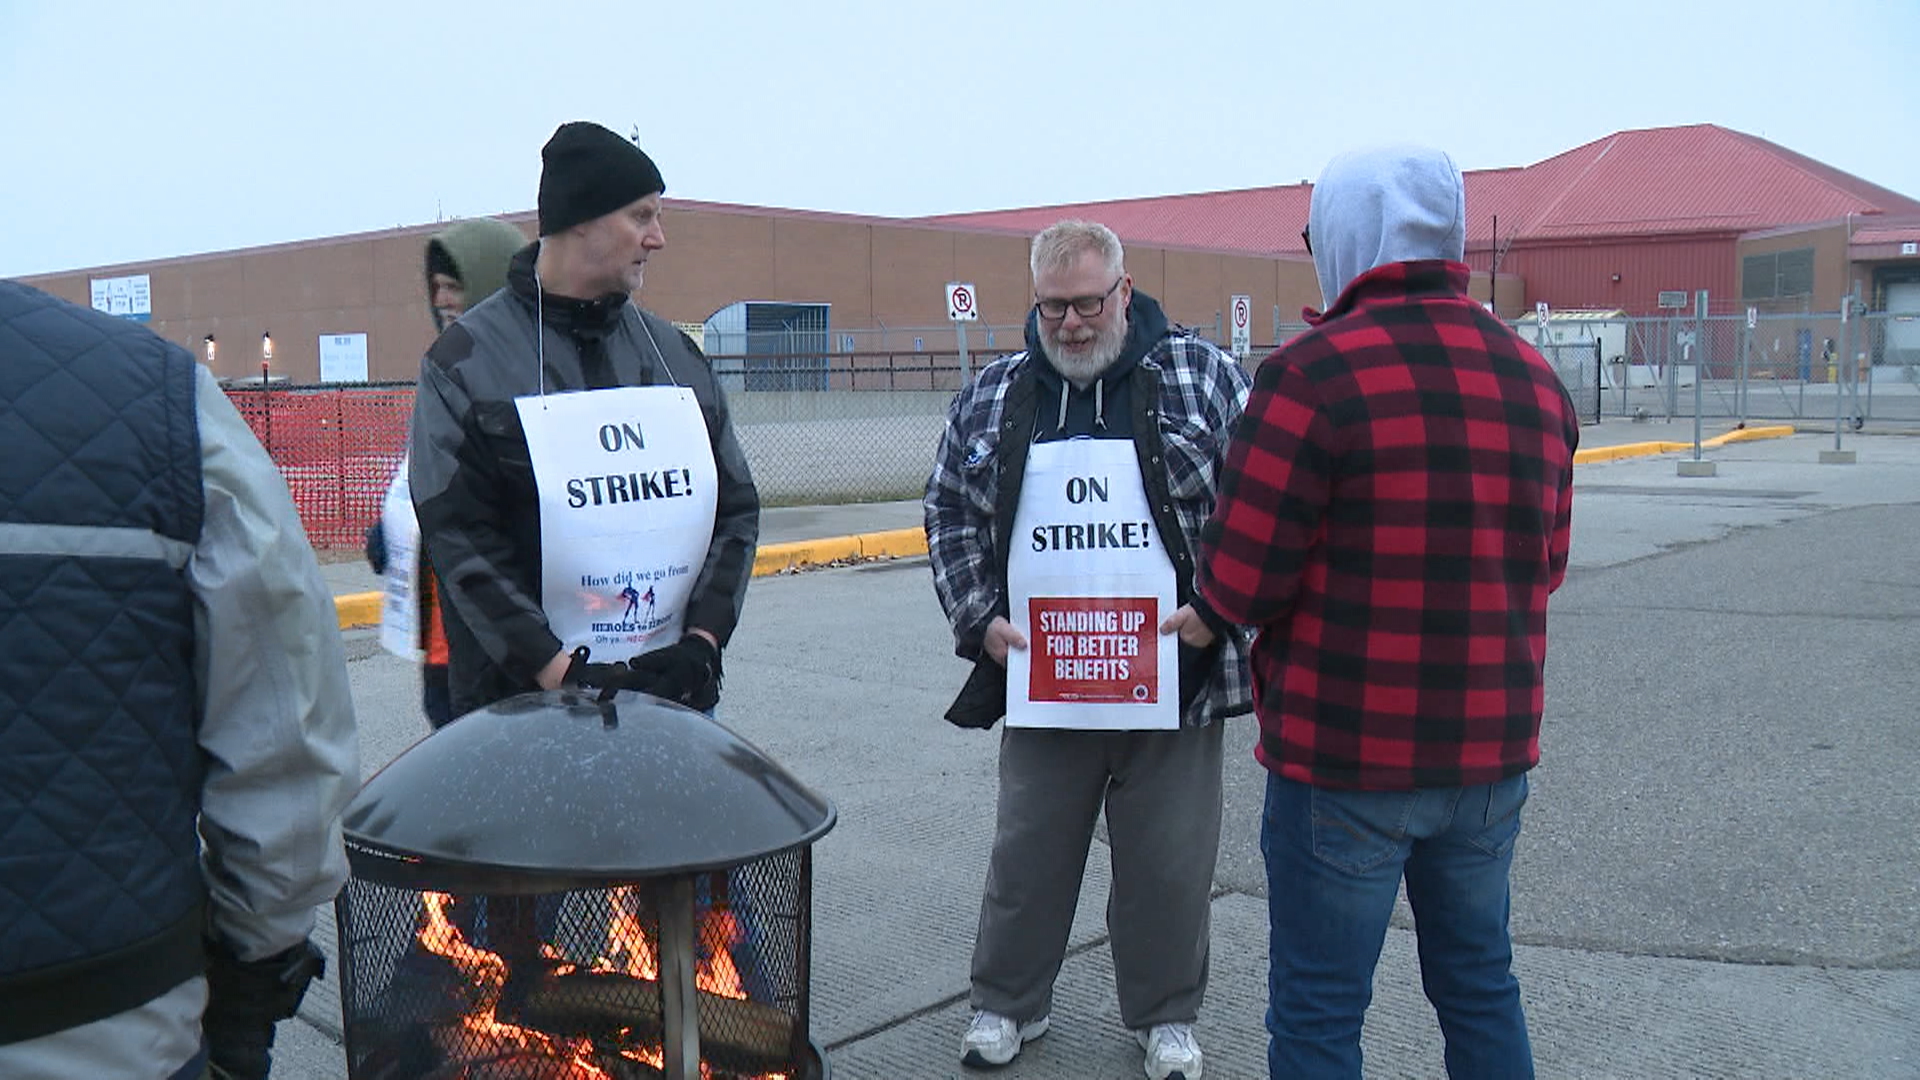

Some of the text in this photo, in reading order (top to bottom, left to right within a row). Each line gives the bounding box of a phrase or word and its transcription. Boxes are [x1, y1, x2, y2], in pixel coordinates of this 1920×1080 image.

[599, 422, 645, 453] ON
[566, 468, 693, 509] STRIKE!
[1065, 476, 1109, 504] ON
[1031, 522, 1150, 552] STRIKE!
[581, 574, 609, 587] How
[613, 571, 633, 584] did
[636, 572, 651, 581] we
[653, 570, 666, 581] go
[1040, 610, 1146, 632] STANDING UP
[1046, 634, 1139, 656] FOR BETTER
[1054, 658, 1130, 680] BENEFITS
